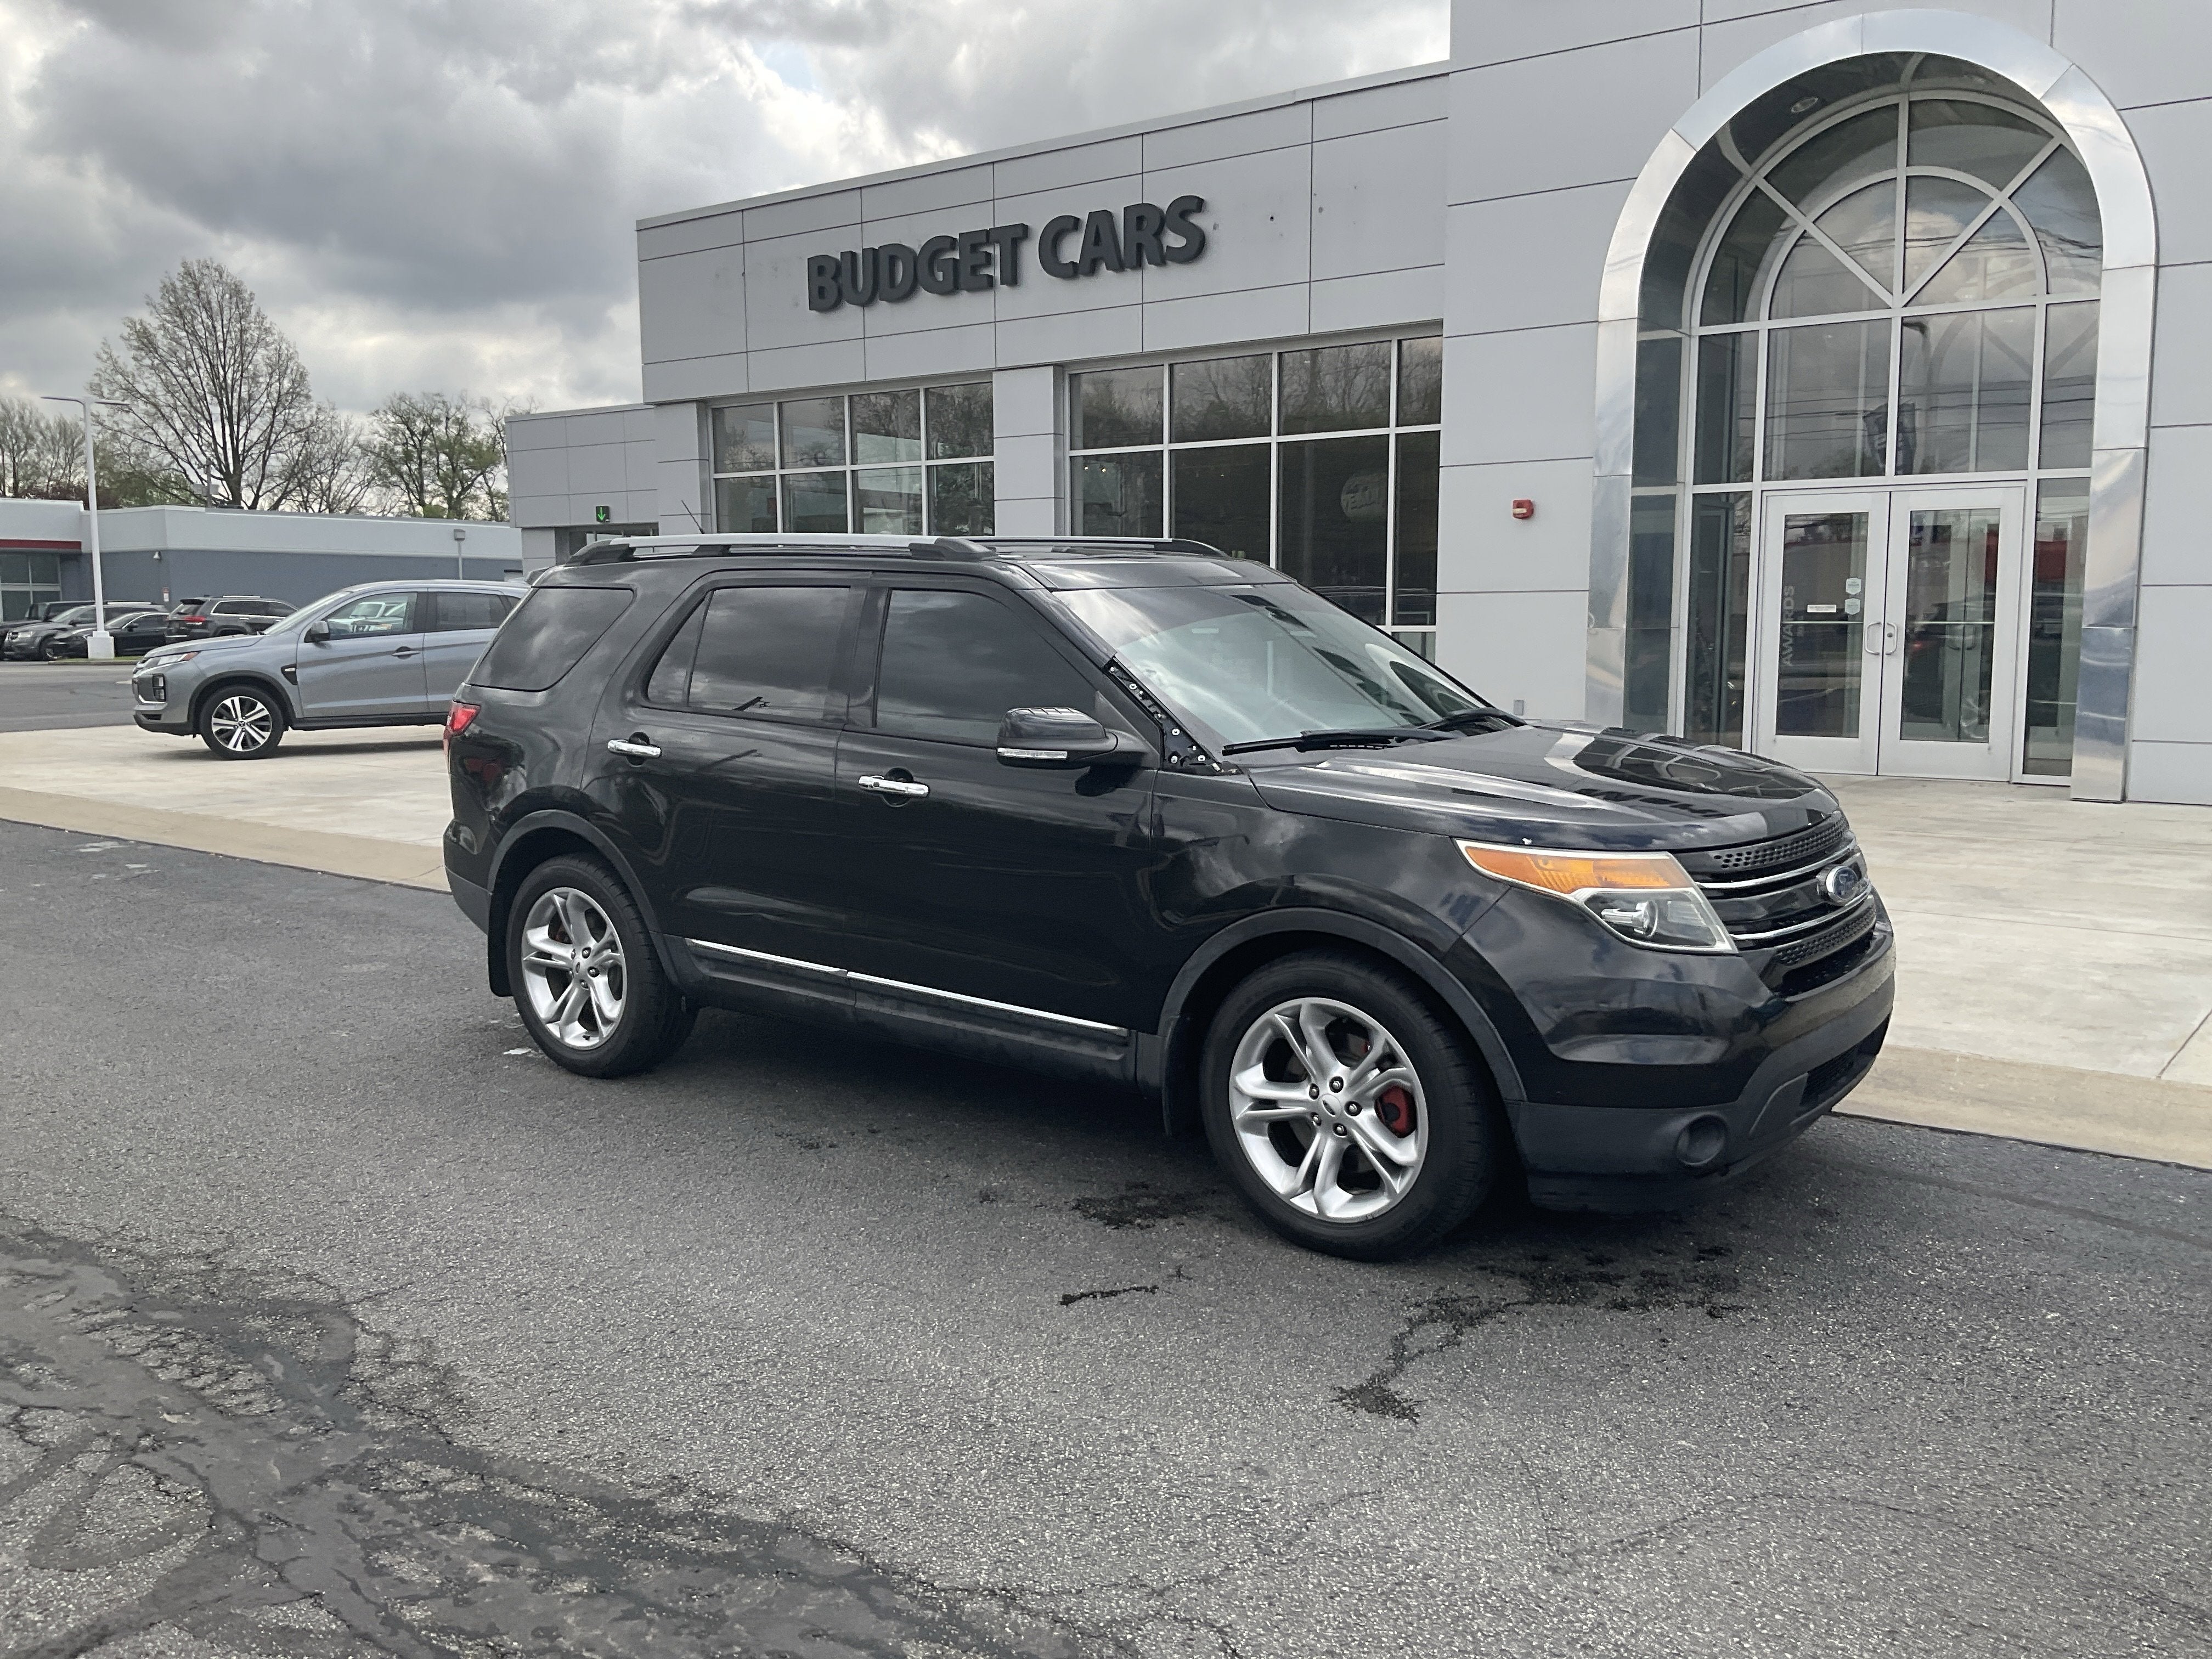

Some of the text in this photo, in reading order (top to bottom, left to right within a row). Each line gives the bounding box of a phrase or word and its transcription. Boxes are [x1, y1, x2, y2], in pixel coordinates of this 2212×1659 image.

[808, 195, 1206, 312] BUDGET CARS
[1782, 585, 1795, 667] AWARDS
